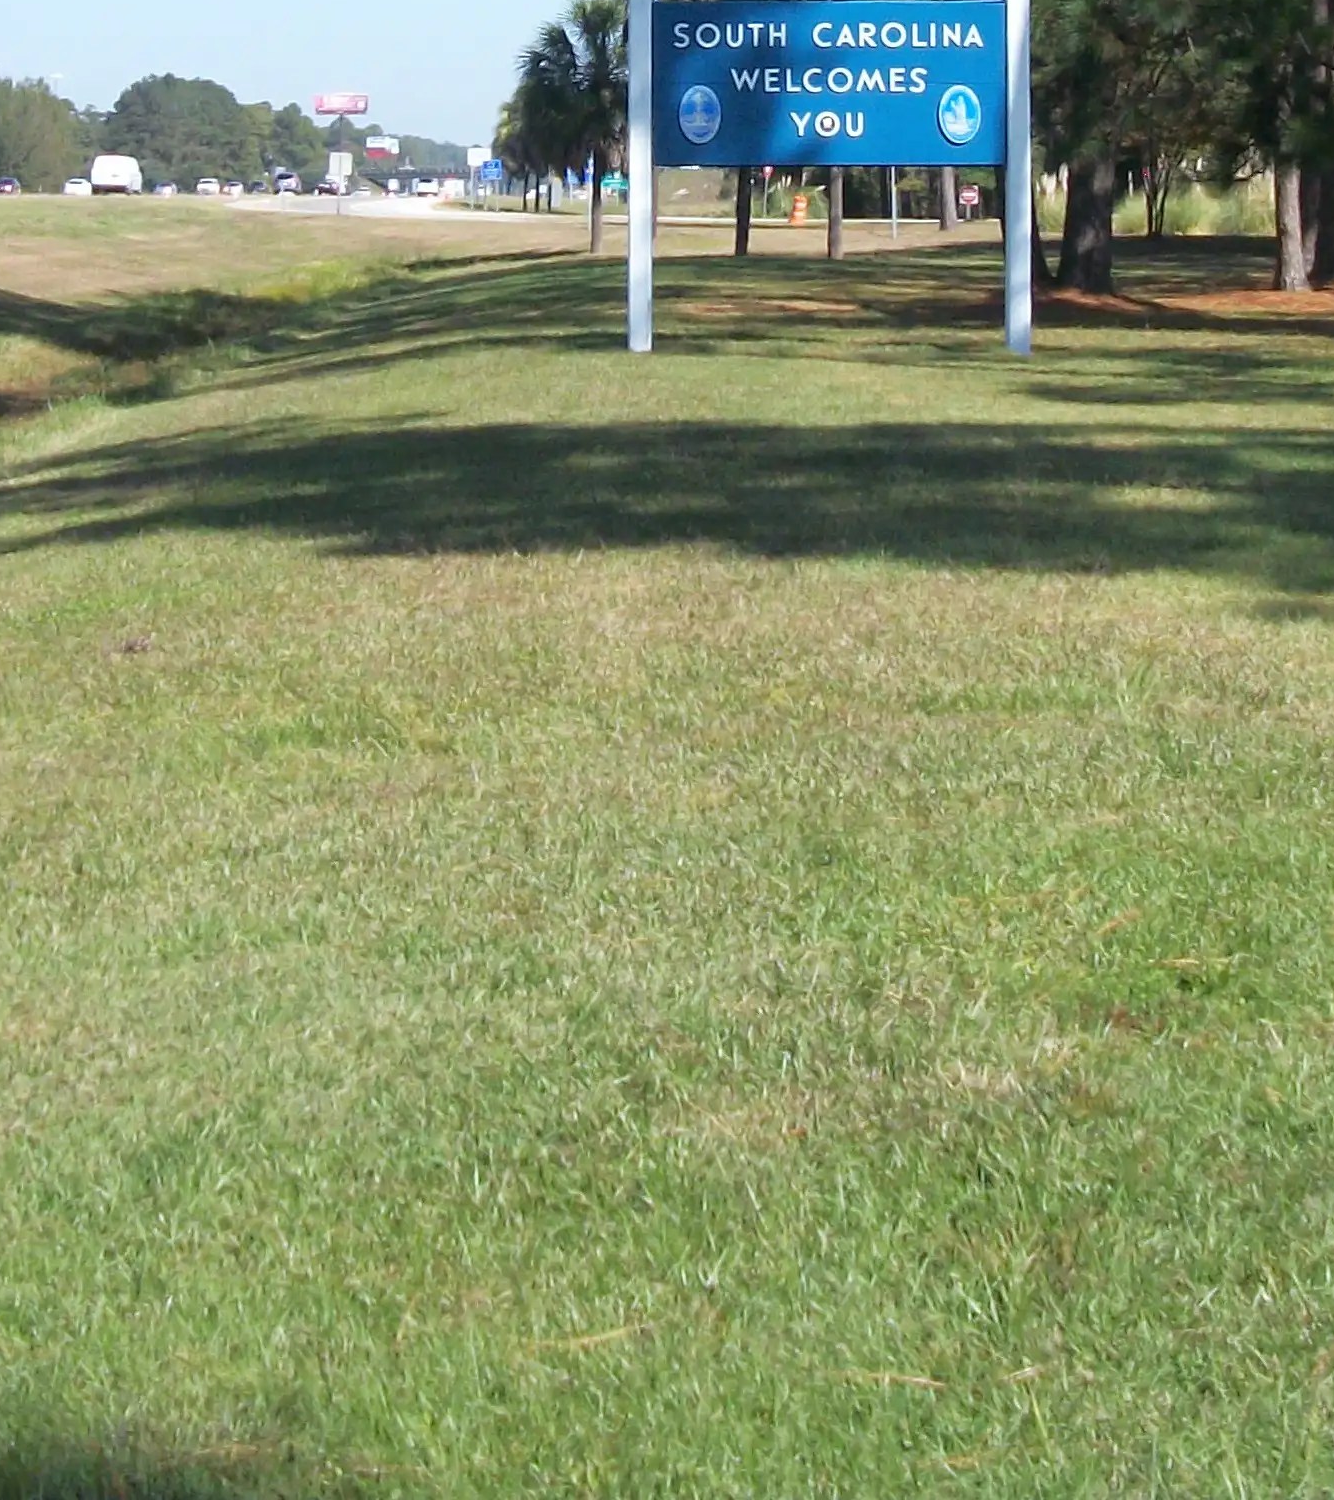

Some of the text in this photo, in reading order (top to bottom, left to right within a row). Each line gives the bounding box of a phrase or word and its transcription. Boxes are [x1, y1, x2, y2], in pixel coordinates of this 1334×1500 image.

[672, 22, 984, 48] SOUTH CAROLINA
[730, 67, 928, 93] WELCOMES
[789, 111, 865, 138] YOU
